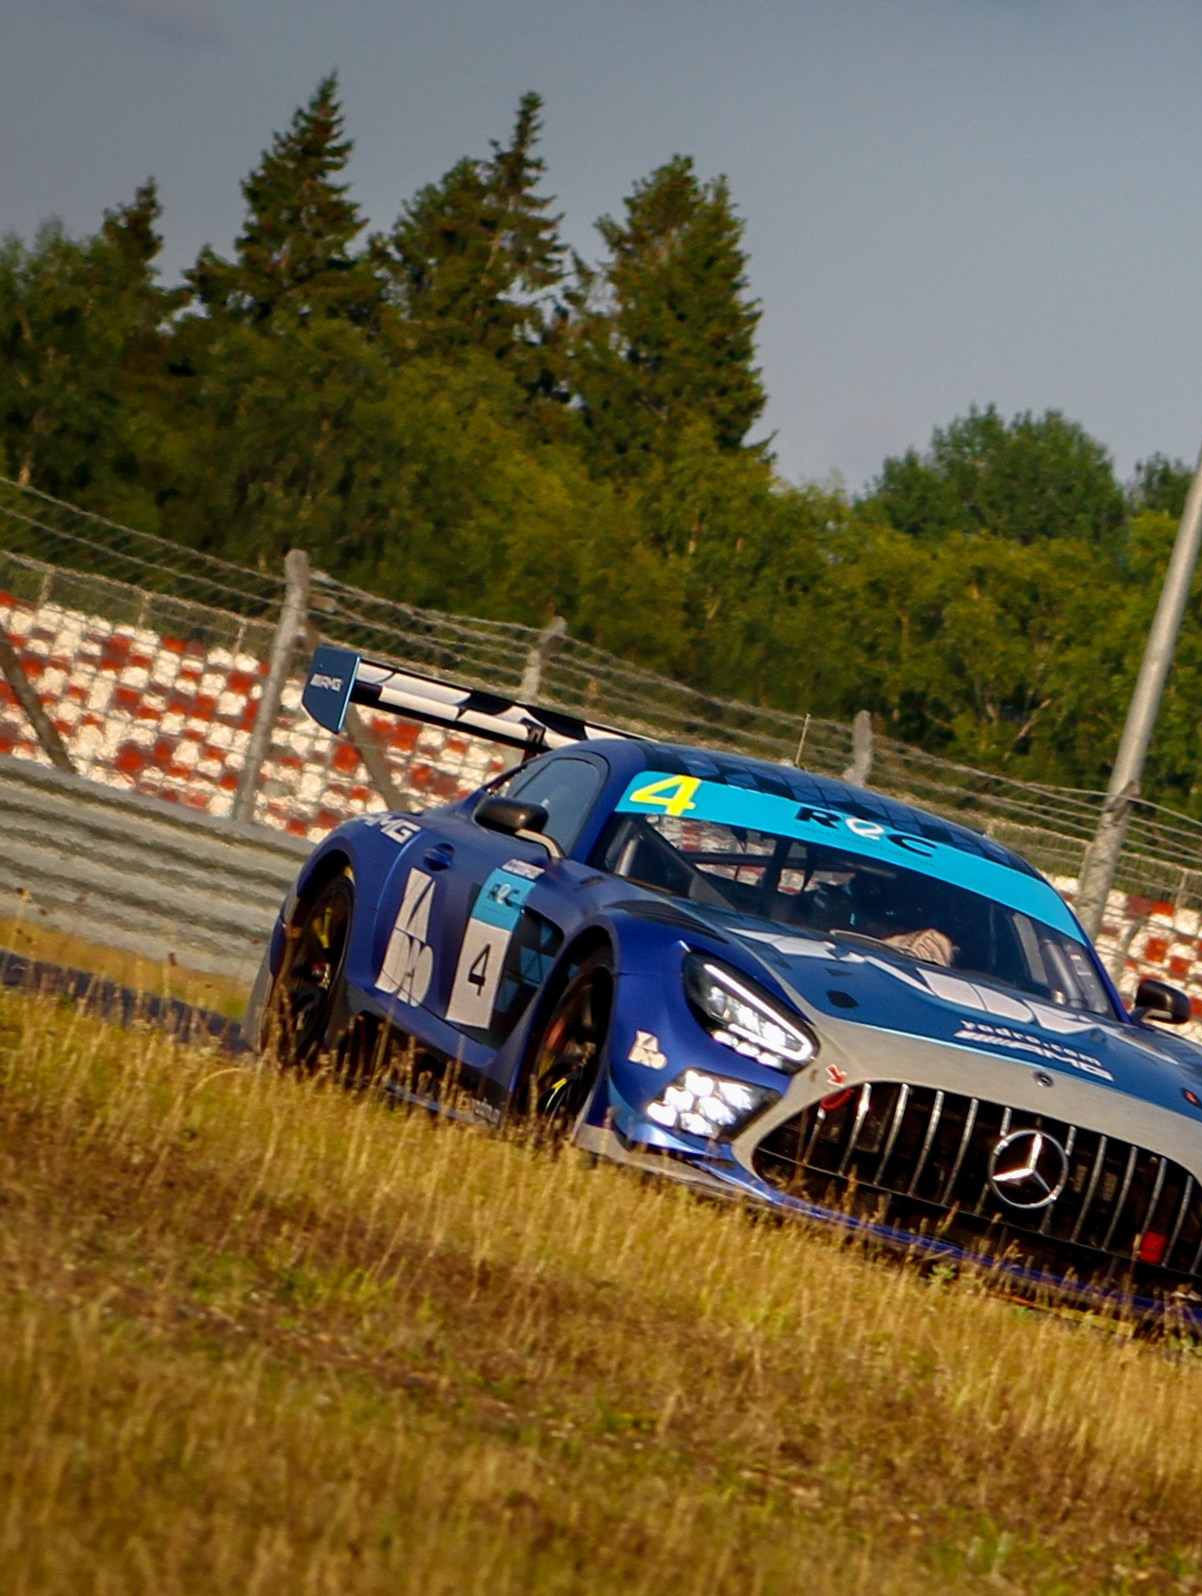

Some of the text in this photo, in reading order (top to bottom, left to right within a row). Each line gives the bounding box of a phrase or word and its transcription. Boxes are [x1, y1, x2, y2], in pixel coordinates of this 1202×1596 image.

[629, 774, 702, 816] 4
[467, 943, 491, 998] 4
[960, 1019, 1102, 1067] yadro.com
